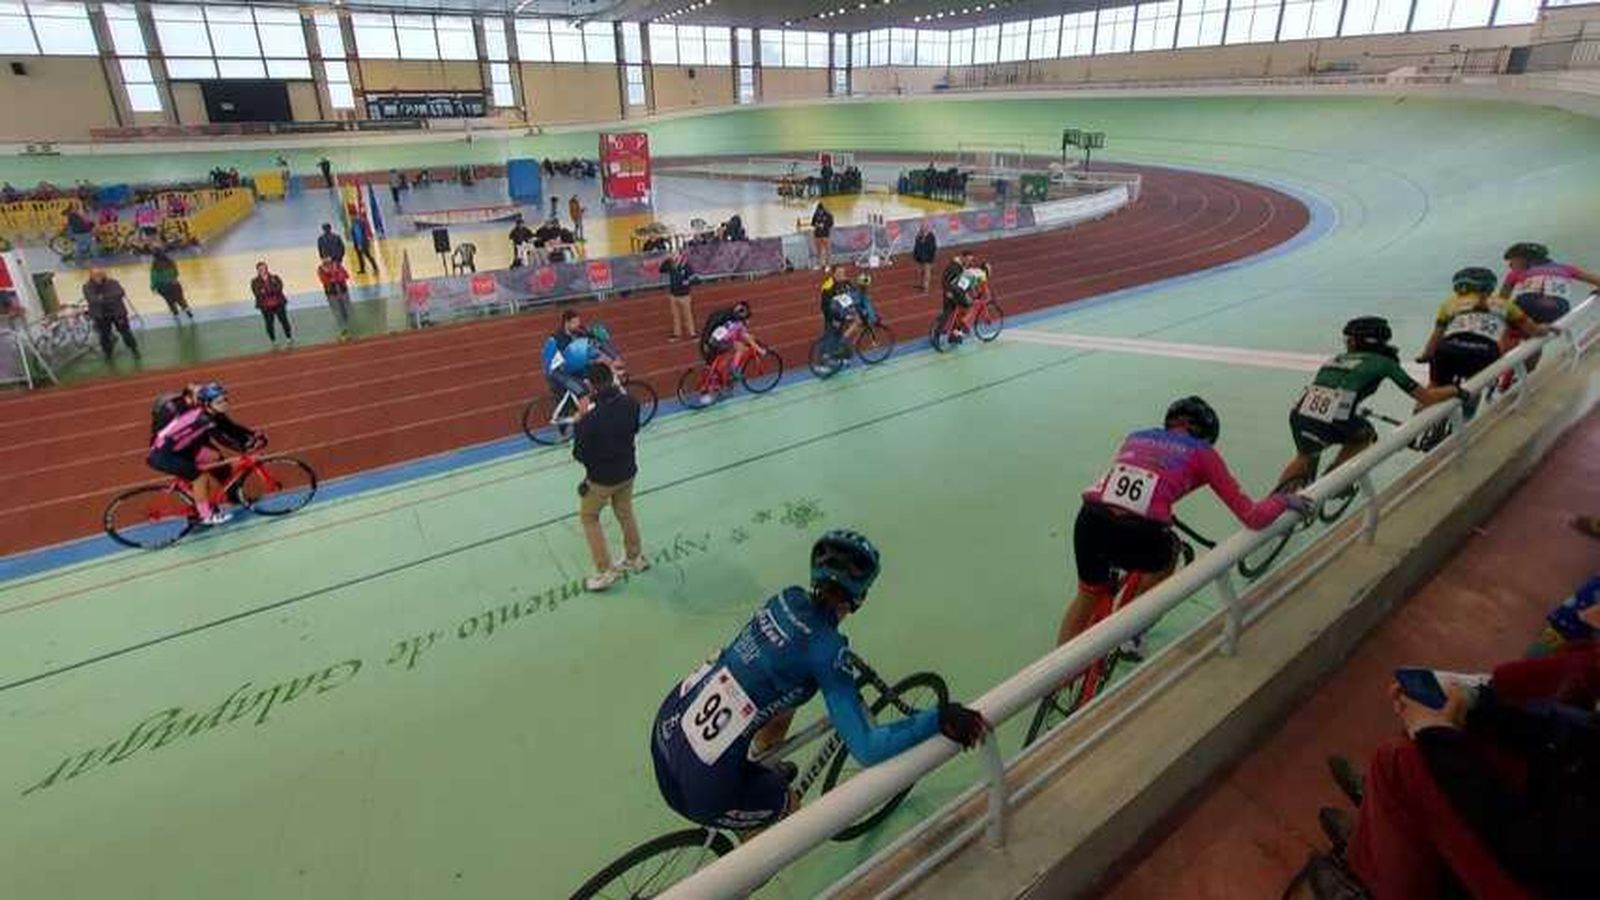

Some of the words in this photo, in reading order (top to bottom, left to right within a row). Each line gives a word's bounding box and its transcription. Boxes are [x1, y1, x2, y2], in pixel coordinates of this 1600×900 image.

[1114, 475, 1144, 502] 96
[457, 531, 711, 640] Ayutmiento
[386, 630, 444, 671] de
[21, 658, 364, 797] Galapagar
